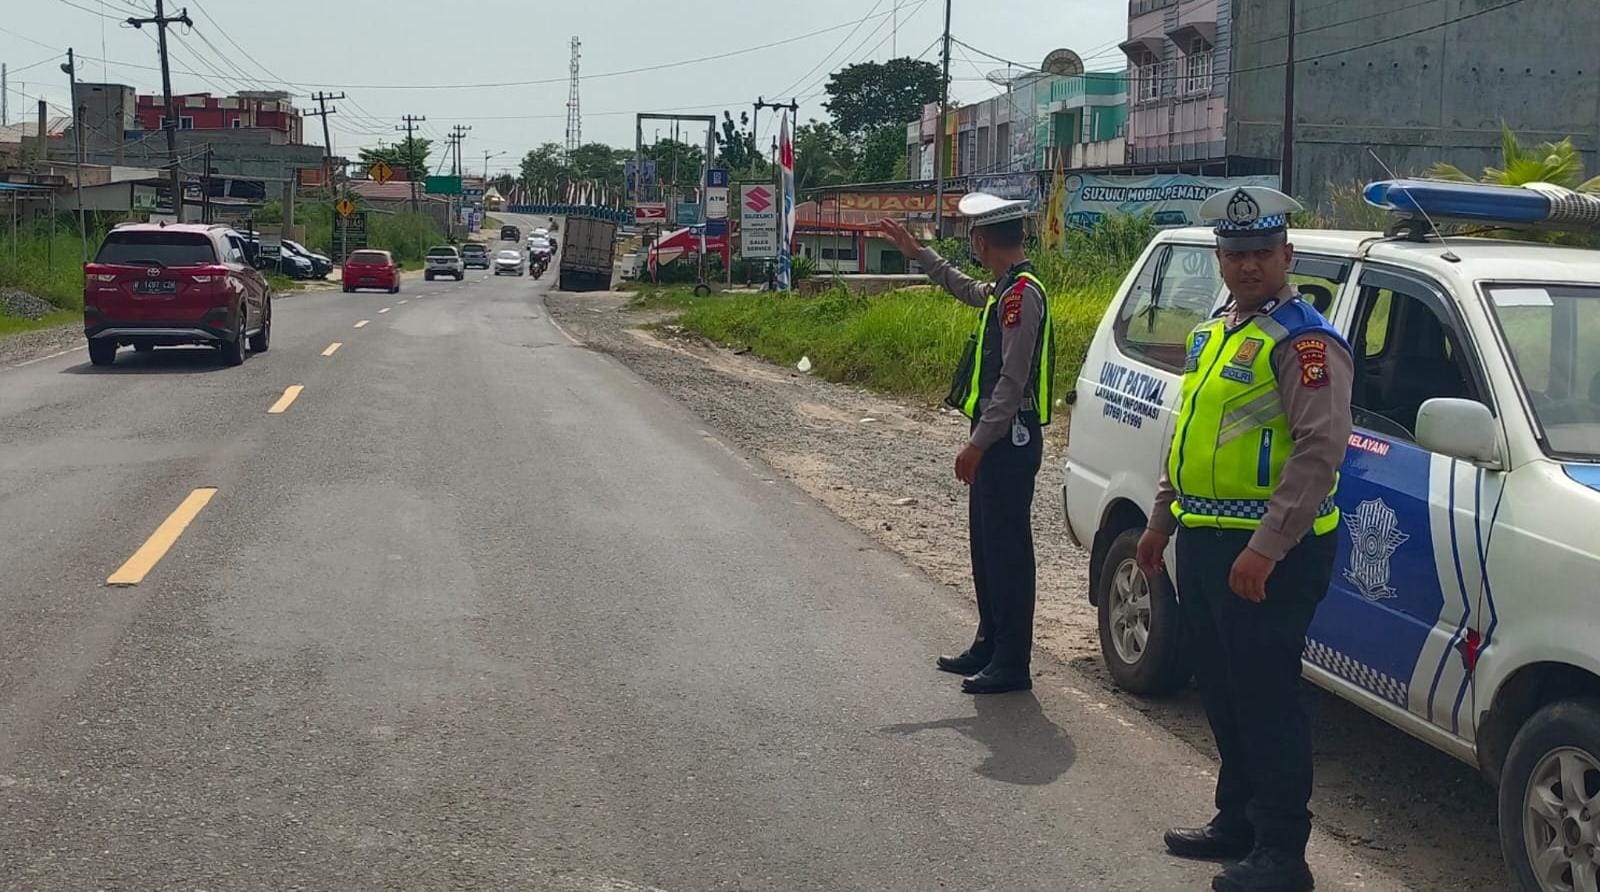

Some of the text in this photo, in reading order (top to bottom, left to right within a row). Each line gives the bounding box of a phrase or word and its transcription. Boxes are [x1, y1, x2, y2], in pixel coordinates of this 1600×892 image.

[1082, 187, 1126, 201] SUZUKI
[1127, 187, 1161, 200] MOBIL
[1100, 361, 1167, 406] UNIT PATWAL
[1223, 368, 1251, 382] POLRI
[1095, 385, 1160, 420] LAYANAN INFORMASI
